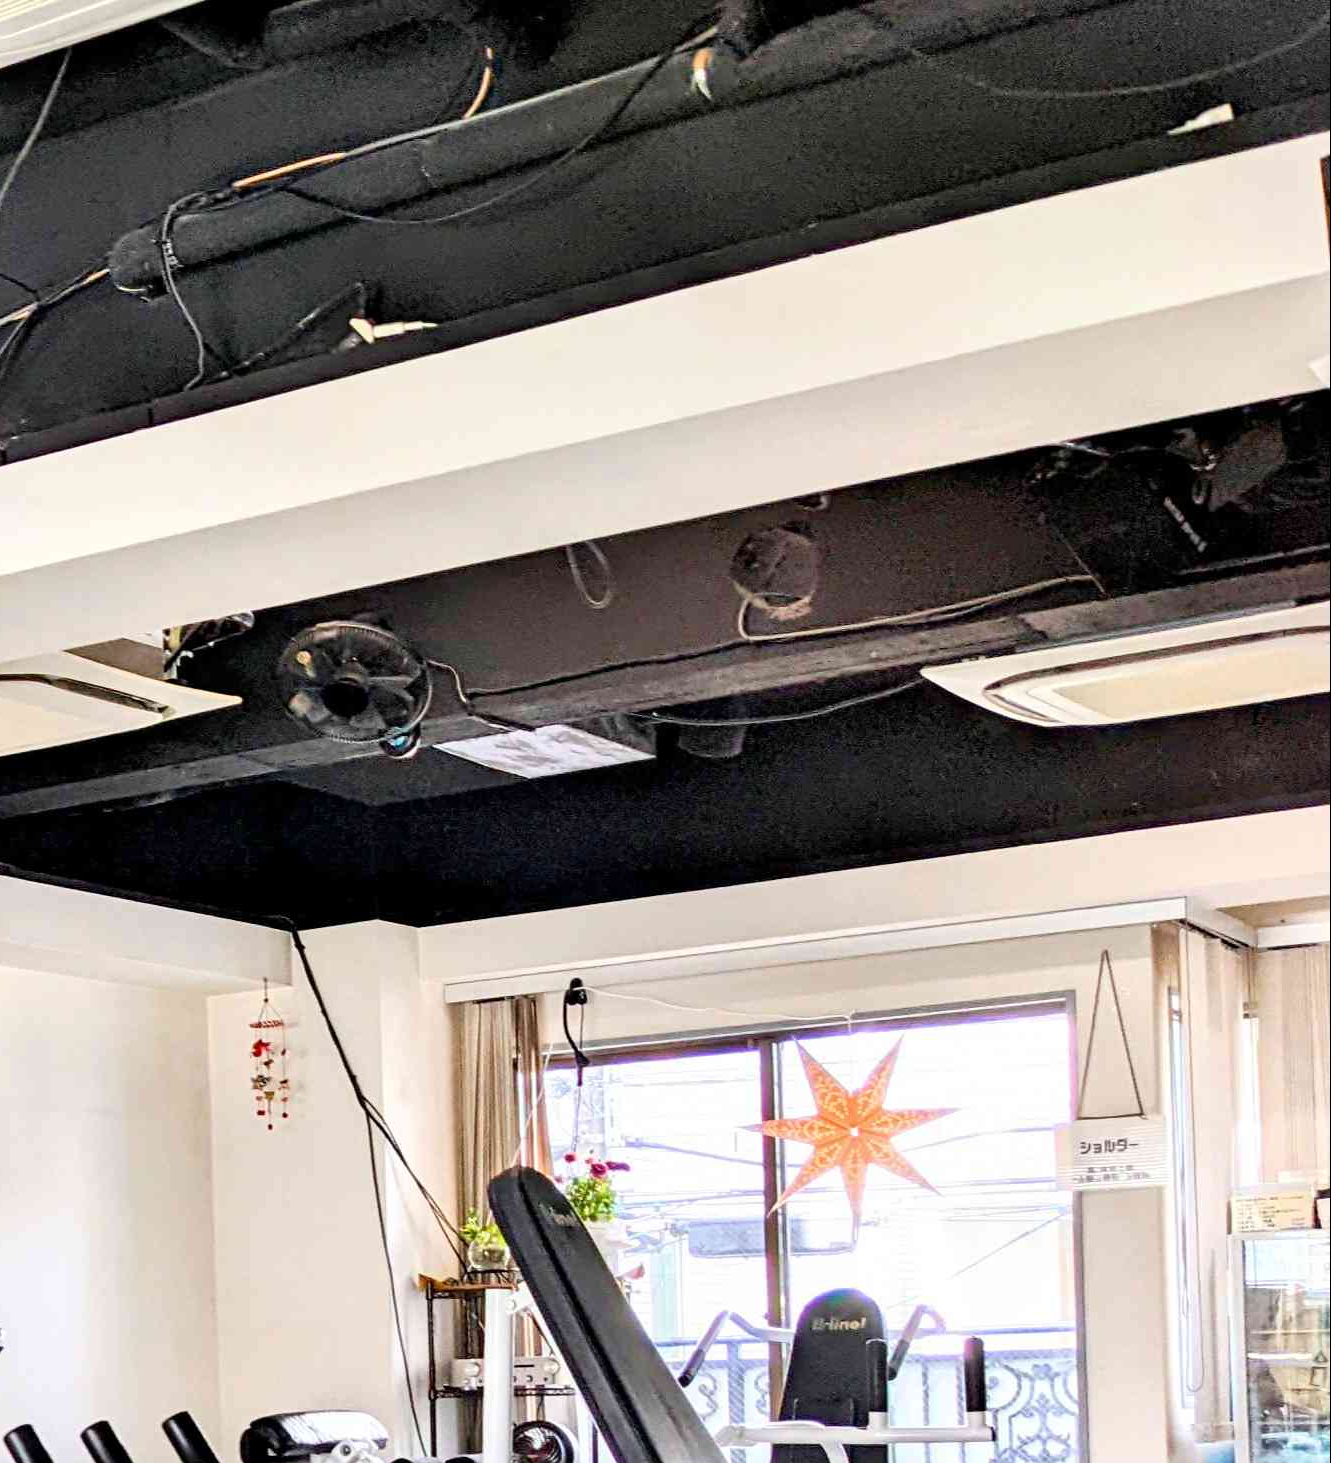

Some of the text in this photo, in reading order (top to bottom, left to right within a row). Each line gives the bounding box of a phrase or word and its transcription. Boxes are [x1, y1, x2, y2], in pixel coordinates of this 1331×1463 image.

[1079, 1138, 1139, 1154] ショルダー
